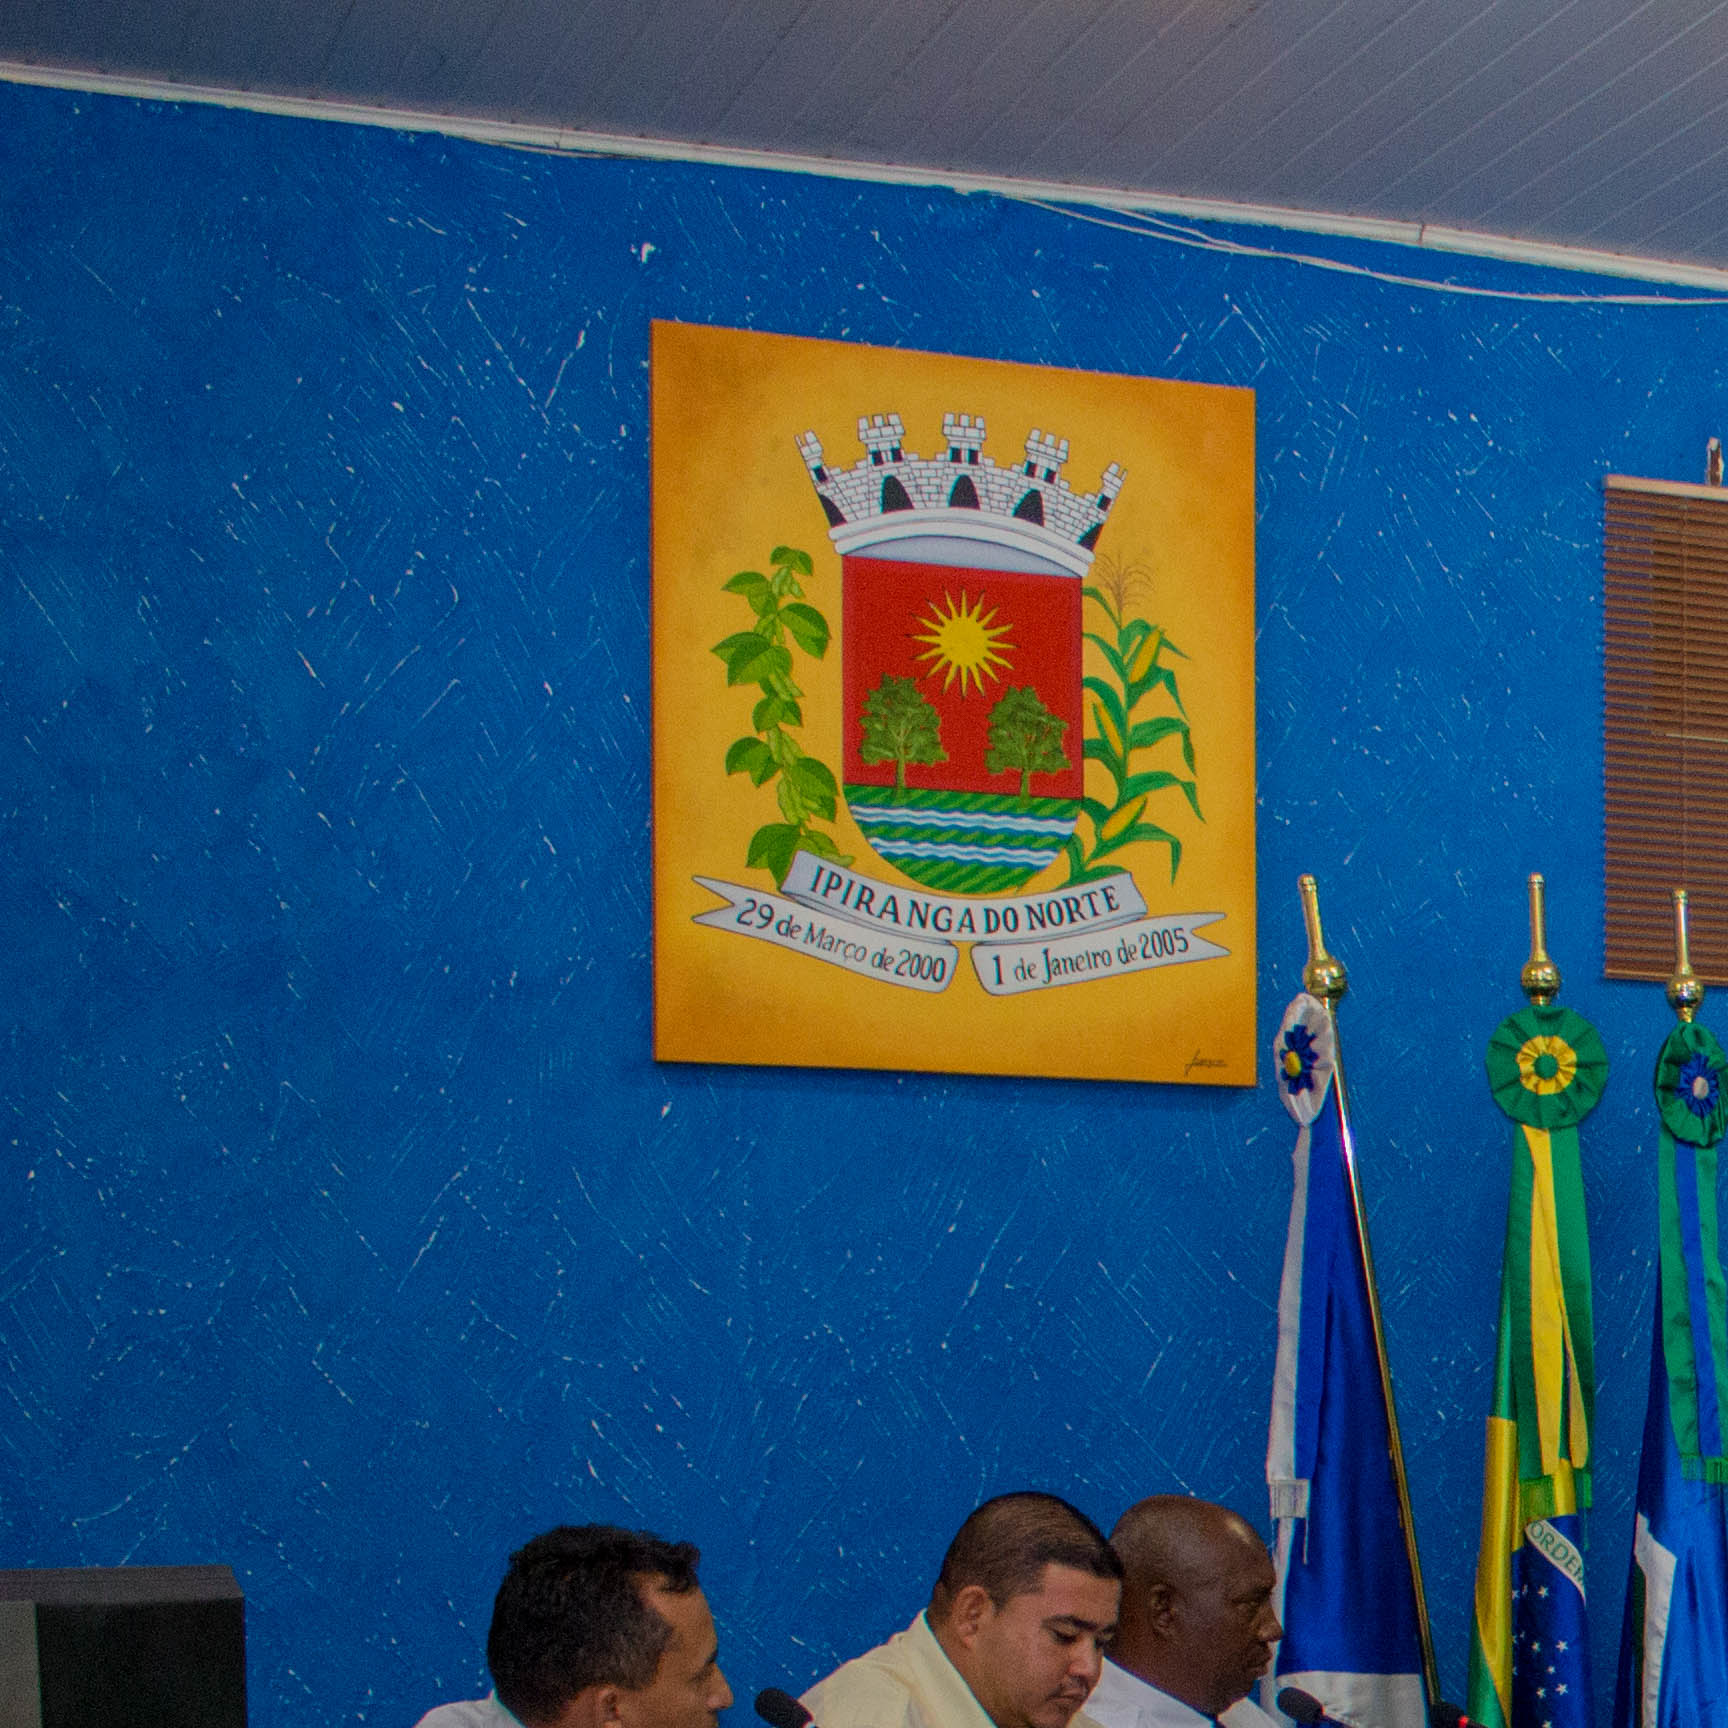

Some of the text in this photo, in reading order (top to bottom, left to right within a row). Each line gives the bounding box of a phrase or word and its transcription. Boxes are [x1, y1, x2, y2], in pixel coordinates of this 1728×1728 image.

[811, 865, 1120, 934] IPIRANGA DO NORTE
[736, 898, 946, 983] 29 de Março de 2000
[992, 927, 1190, 985] 1 de Janeiro de 2005
[1530, 1522, 1583, 1582] ORDE
